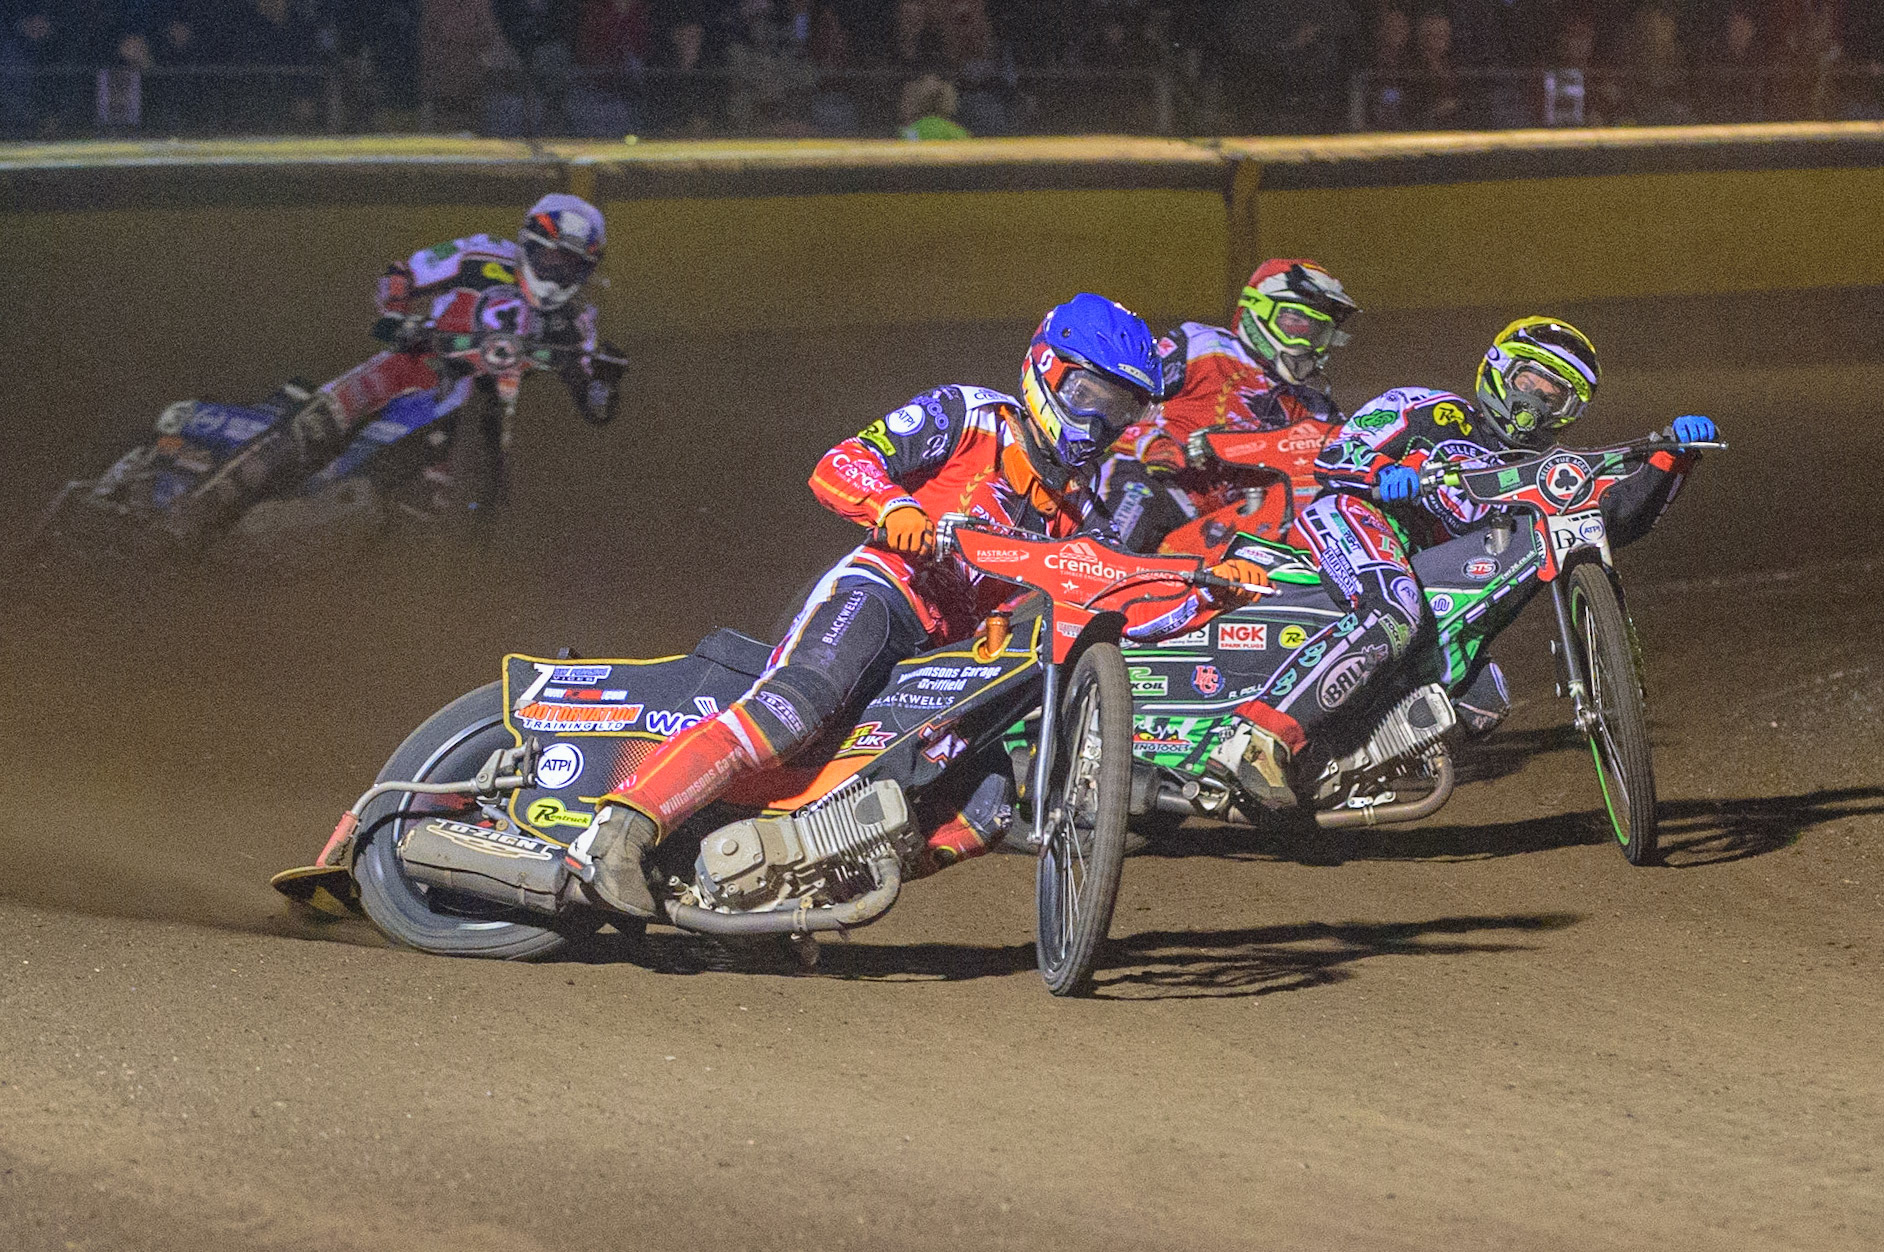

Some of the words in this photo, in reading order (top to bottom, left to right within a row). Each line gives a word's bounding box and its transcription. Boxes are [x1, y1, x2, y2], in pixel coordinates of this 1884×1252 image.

[897, 410, 915, 428] ATPI
[1278, 435, 1335, 452] Crendo
[1555, 456, 1570, 464] VUE
[1572, 459, 1589, 473] ACES
[1583, 525, 1602, 535] ATPI
[976, 549, 1019, 558] FASTRACK
[1044, 554, 1127, 582] Crendon
[1469, 563, 1493, 572] STS
[821, 590, 865, 645] BLACKWELL'S
[1220, 626, 1265, 642] NGK
[960, 665, 1002, 680] Garage
[1142, 682, 1165, 690] OIL
[869, 692, 955, 706] BLACKWELL'S
[519, 702, 641, 722] MOTORVATION
[524, 720, 594, 730] TRAINING
[597, 721, 624, 730] LTD
[856, 735, 885, 746] UK
[540, 758, 572, 773] ATPI
[659, 768, 717, 816] Williamsons
[534, 803, 589, 825] Rentruck
